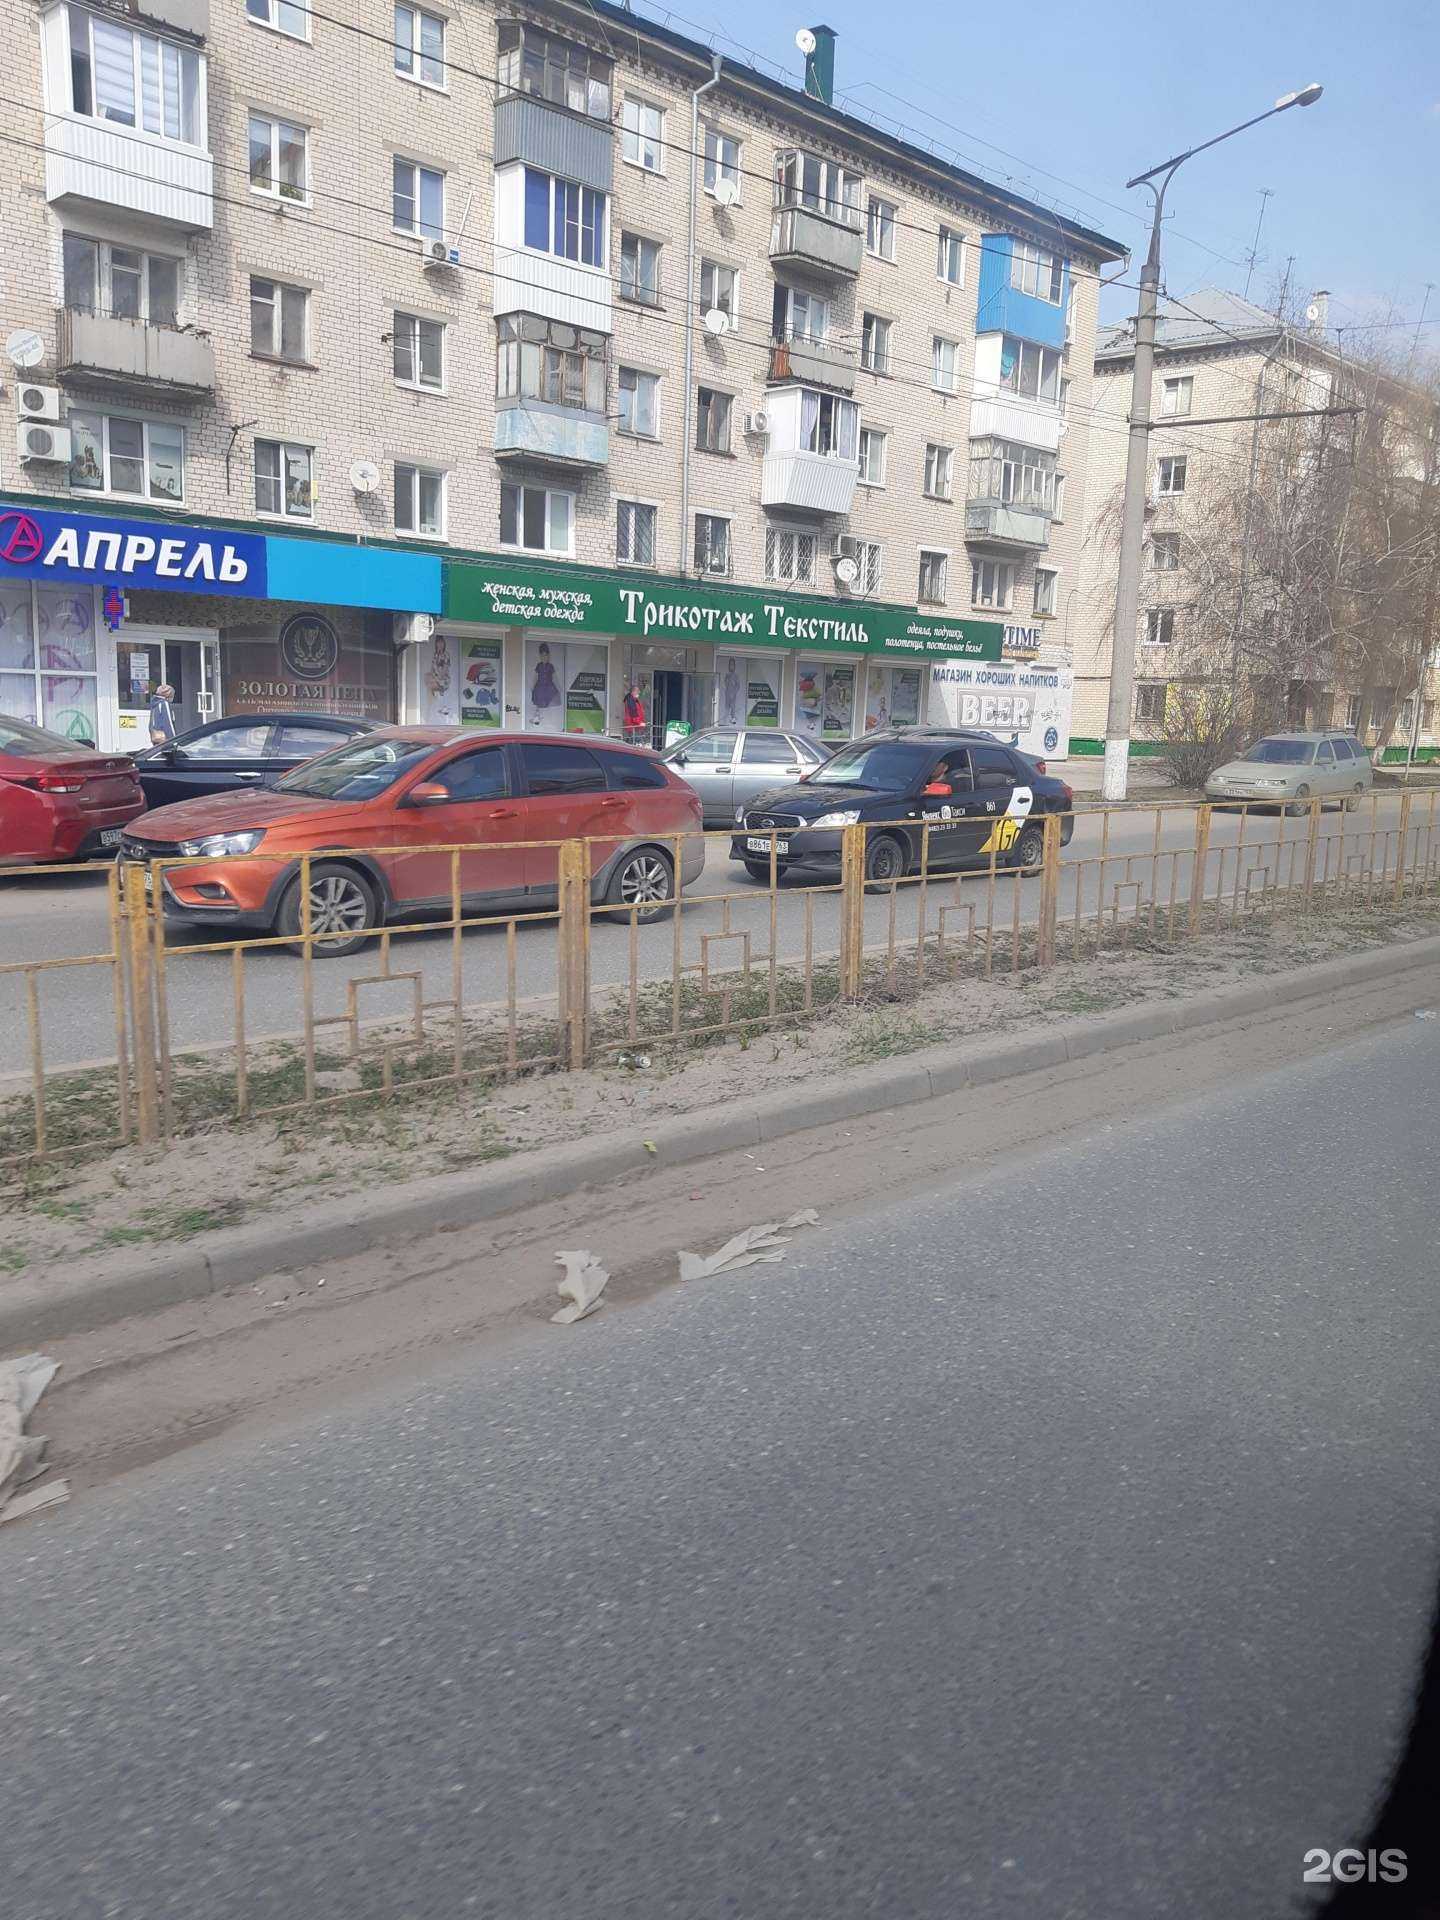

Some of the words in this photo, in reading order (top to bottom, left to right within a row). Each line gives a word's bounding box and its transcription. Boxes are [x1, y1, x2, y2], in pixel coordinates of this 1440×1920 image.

[43, 528, 248, 582] АПРЕЛЬ
[481, 580, 536, 600] женская,
[539, 589, 593, 607] мужская,
[492, 598, 541, 619] детская
[544, 606, 584, 623] одежда
[907, 621, 932, 638] одеяла,
[934, 625, 964, 641] подушки,
[1006, 626, 1041, 646] TIME
[885, 637, 925, 652] полотенца,
[926, 640, 963, 652] постельное
[964, 640, 984, 653] бельё
[933, 667, 973, 684] МАГАЗИН
[975, 669, 1016, 685] ХОРОШИХ
[1018, 672, 1060, 688] НАПИТКОВ
[239, 681, 324, 699] ЗОЛОТАЯ
[959, 692, 1032, 729] BEER
[951, 806, 966, 816] Такси
[986, 801, 996, 812] 861
